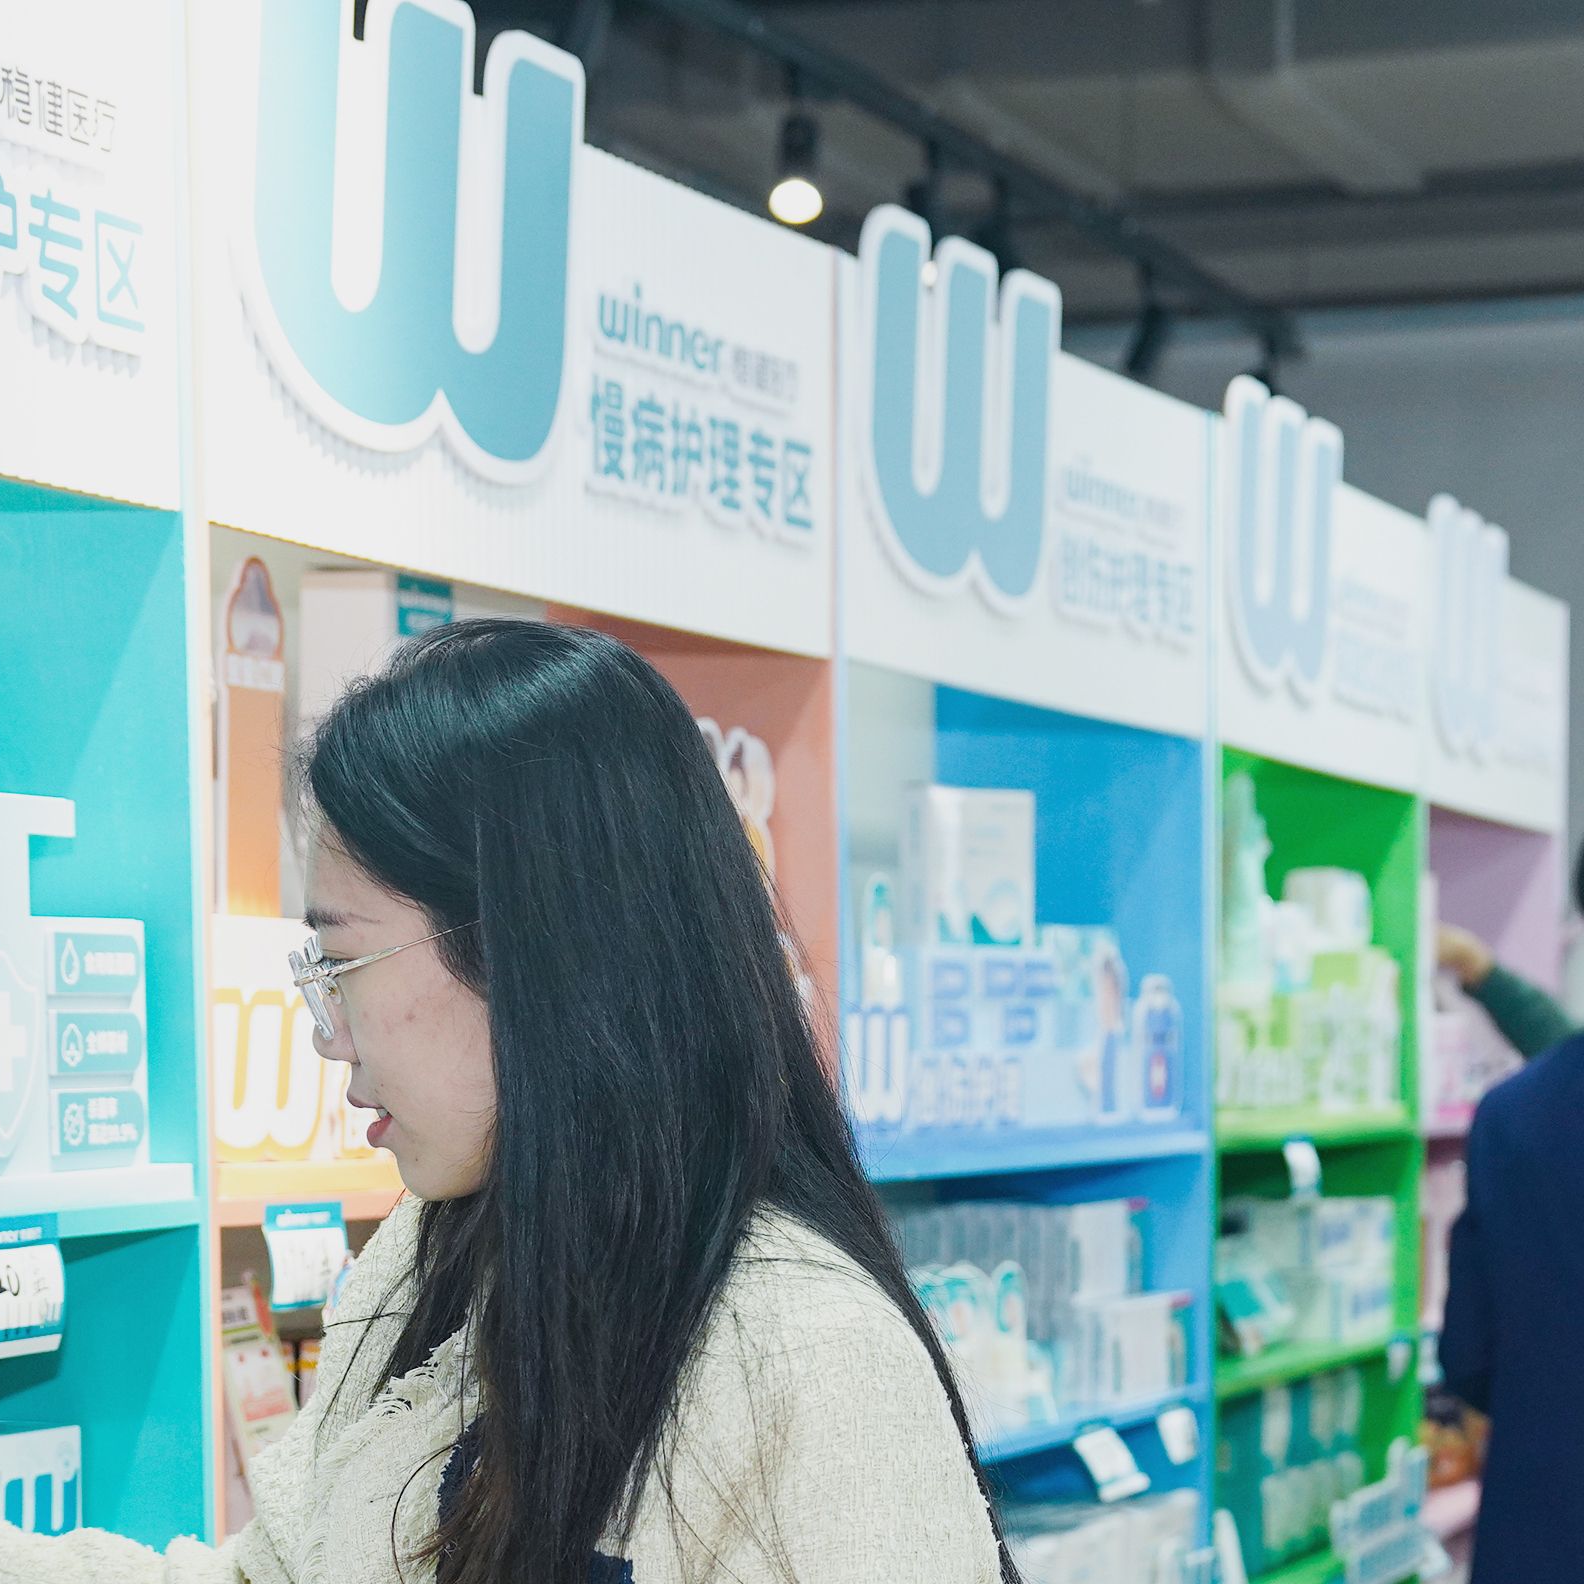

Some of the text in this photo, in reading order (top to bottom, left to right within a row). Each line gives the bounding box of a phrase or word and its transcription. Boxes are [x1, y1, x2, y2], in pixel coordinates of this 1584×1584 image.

[0, 64, 117, 152] 稳健医疗
[599, 282, 725, 372] winner
[590, 373, 813, 528] 慢病护理专区
